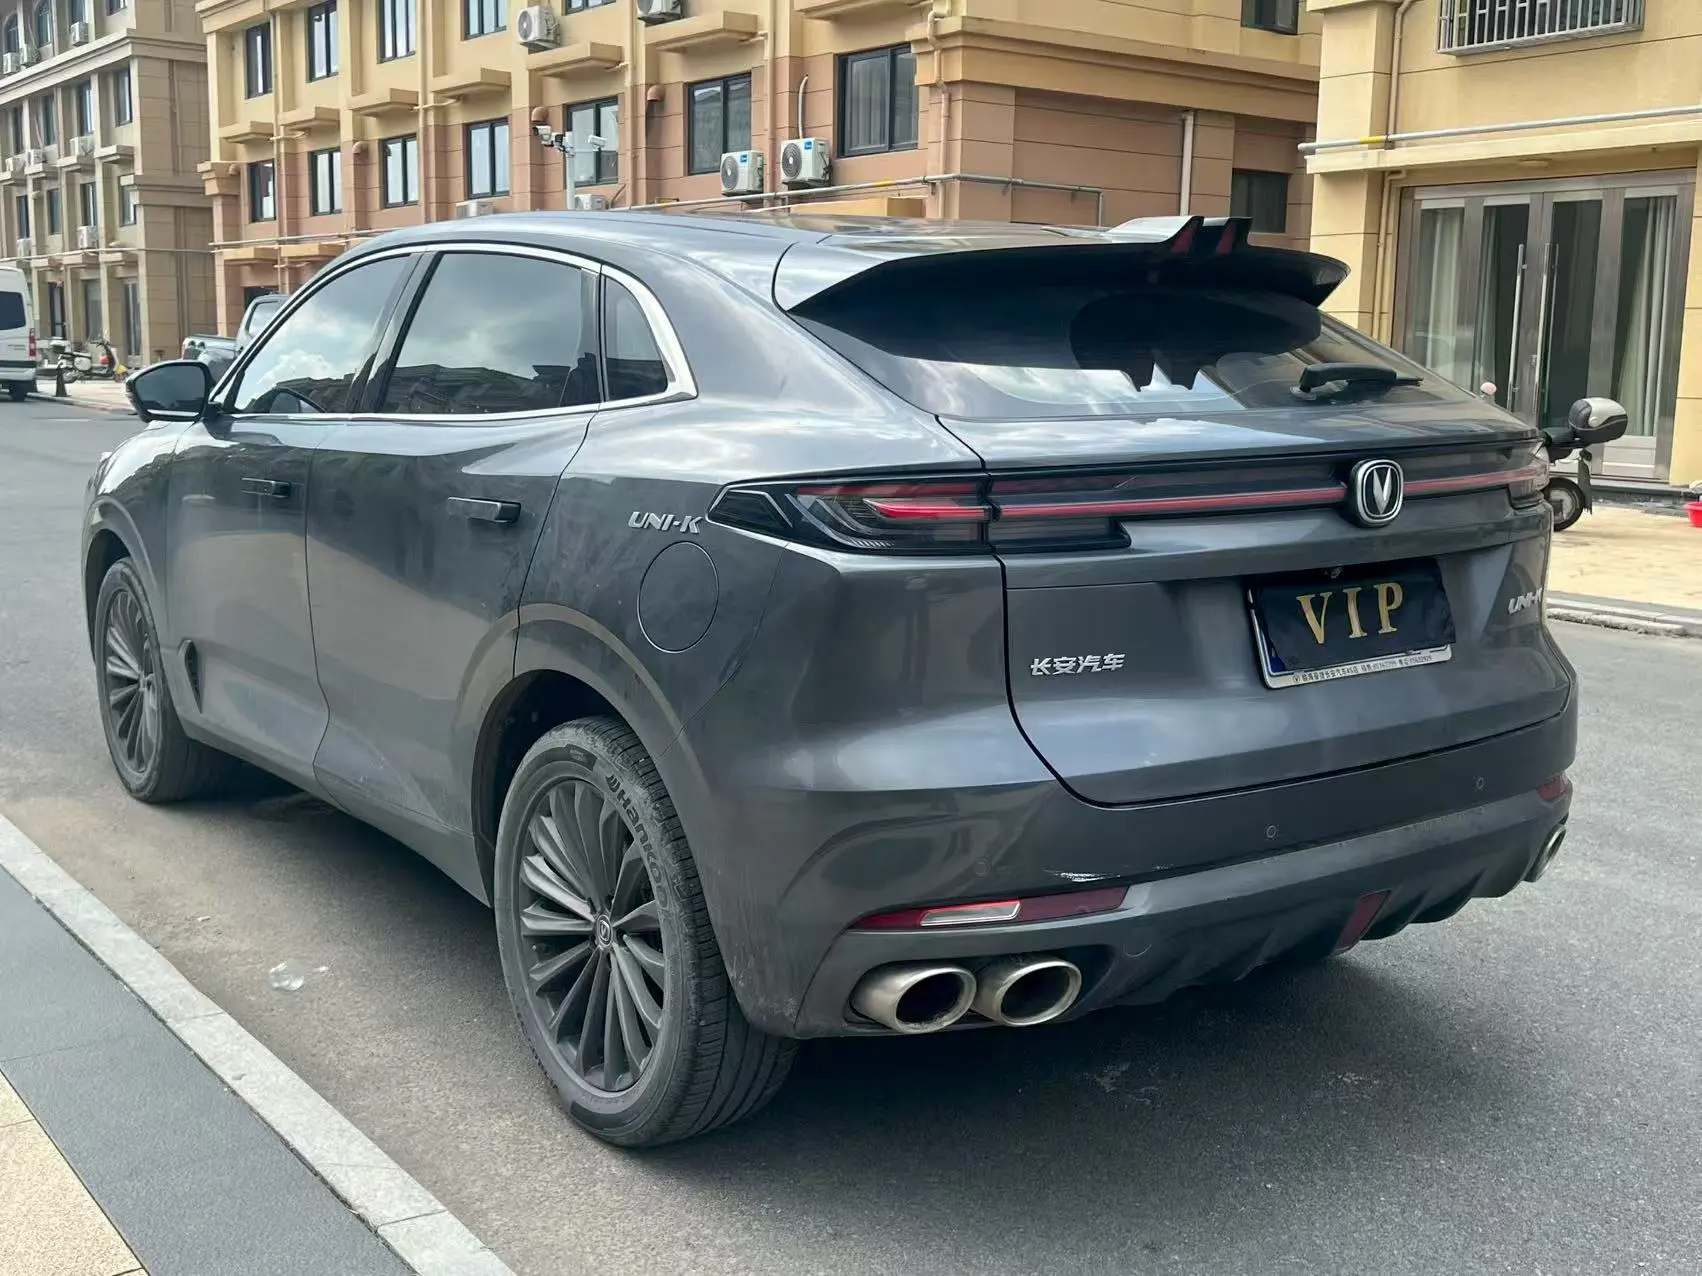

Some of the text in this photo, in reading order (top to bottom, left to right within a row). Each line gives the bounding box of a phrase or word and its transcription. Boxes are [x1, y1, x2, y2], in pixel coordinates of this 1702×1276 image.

[627, 511, 703, 534] UNI-K
[1296, 582, 1404, 645] VIP
[1030, 653, 1126, 676] 长安汽车
